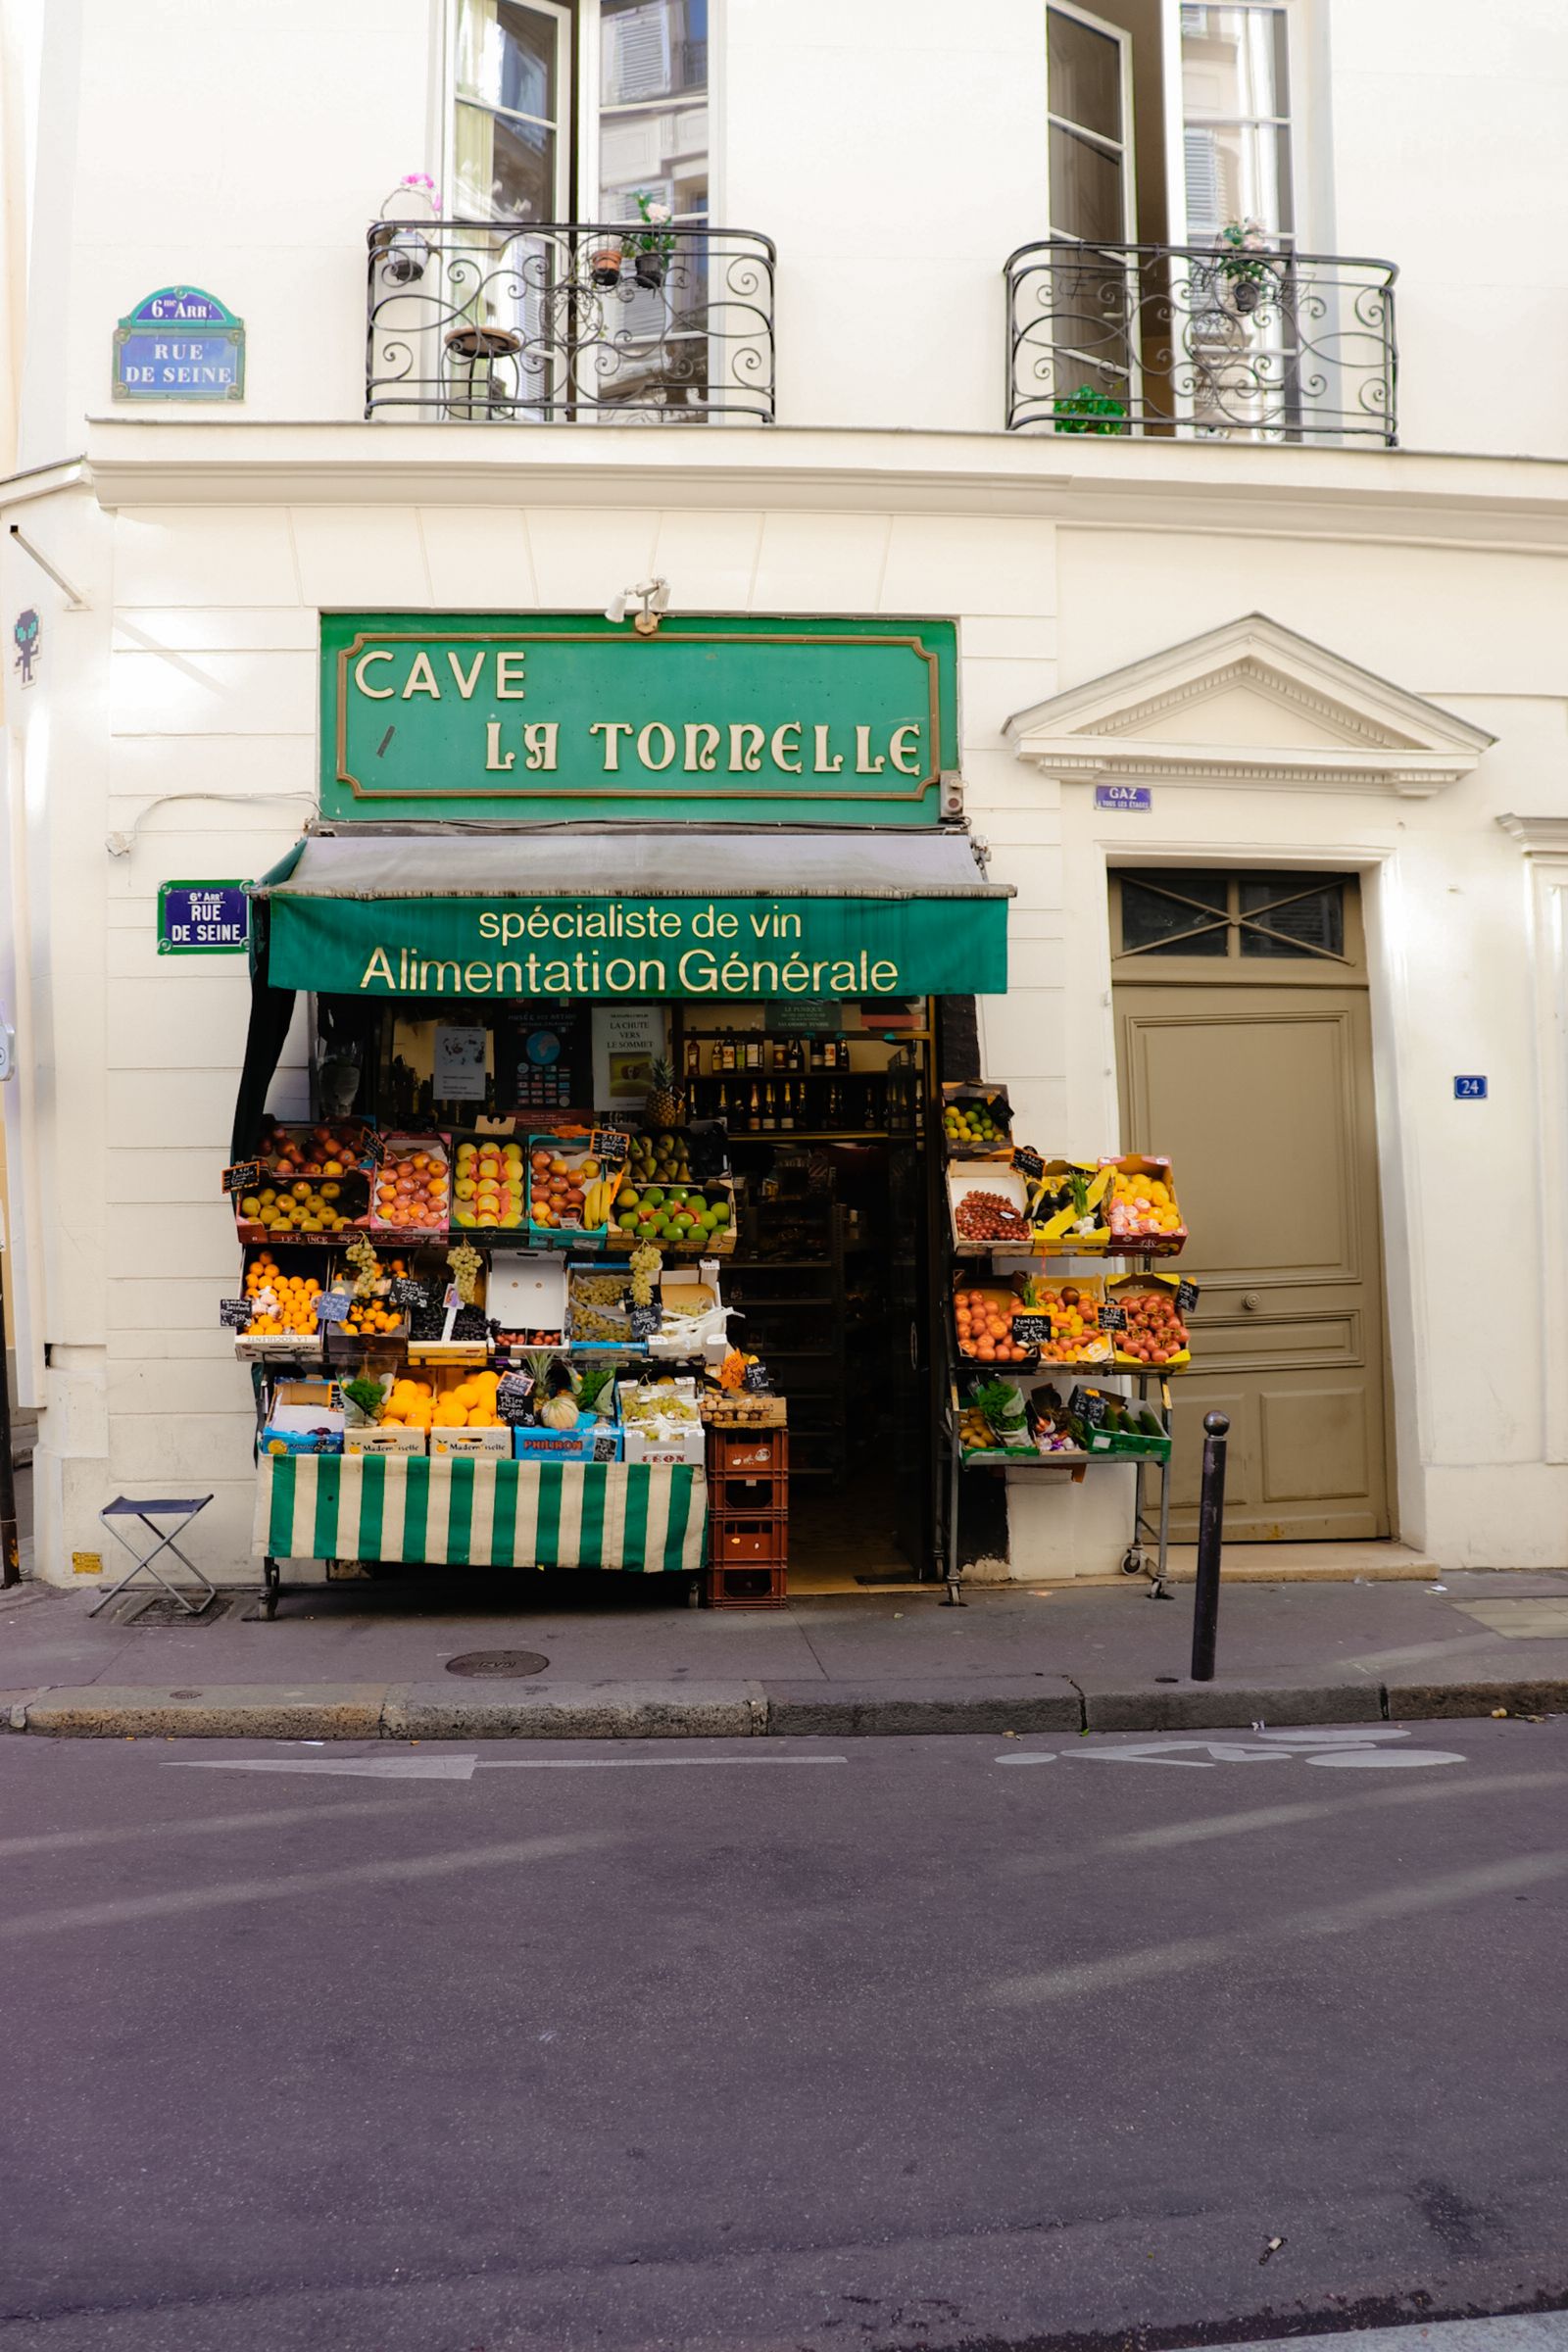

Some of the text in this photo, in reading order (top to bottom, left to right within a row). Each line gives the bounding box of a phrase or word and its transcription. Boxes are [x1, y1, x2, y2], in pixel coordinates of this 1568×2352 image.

[154, 343, 204, 361] RUE
[124, 366, 232, 384] DE SEINE
[354, 650, 525, 700] CAVE
[485, 720, 922, 777] LA TONNELLE
[1108, 787, 1138, 801] GAZ
[190, 904, 221, 921] RUE
[172, 923, 241, 942] DE SEINE
[478, 904, 802, 947] spécialiste de vin
[359, 946, 899, 994] Alimentation Générale
[607, 1041, 618, 1050] LE
[1460, 1079, 1480, 1095] 24
